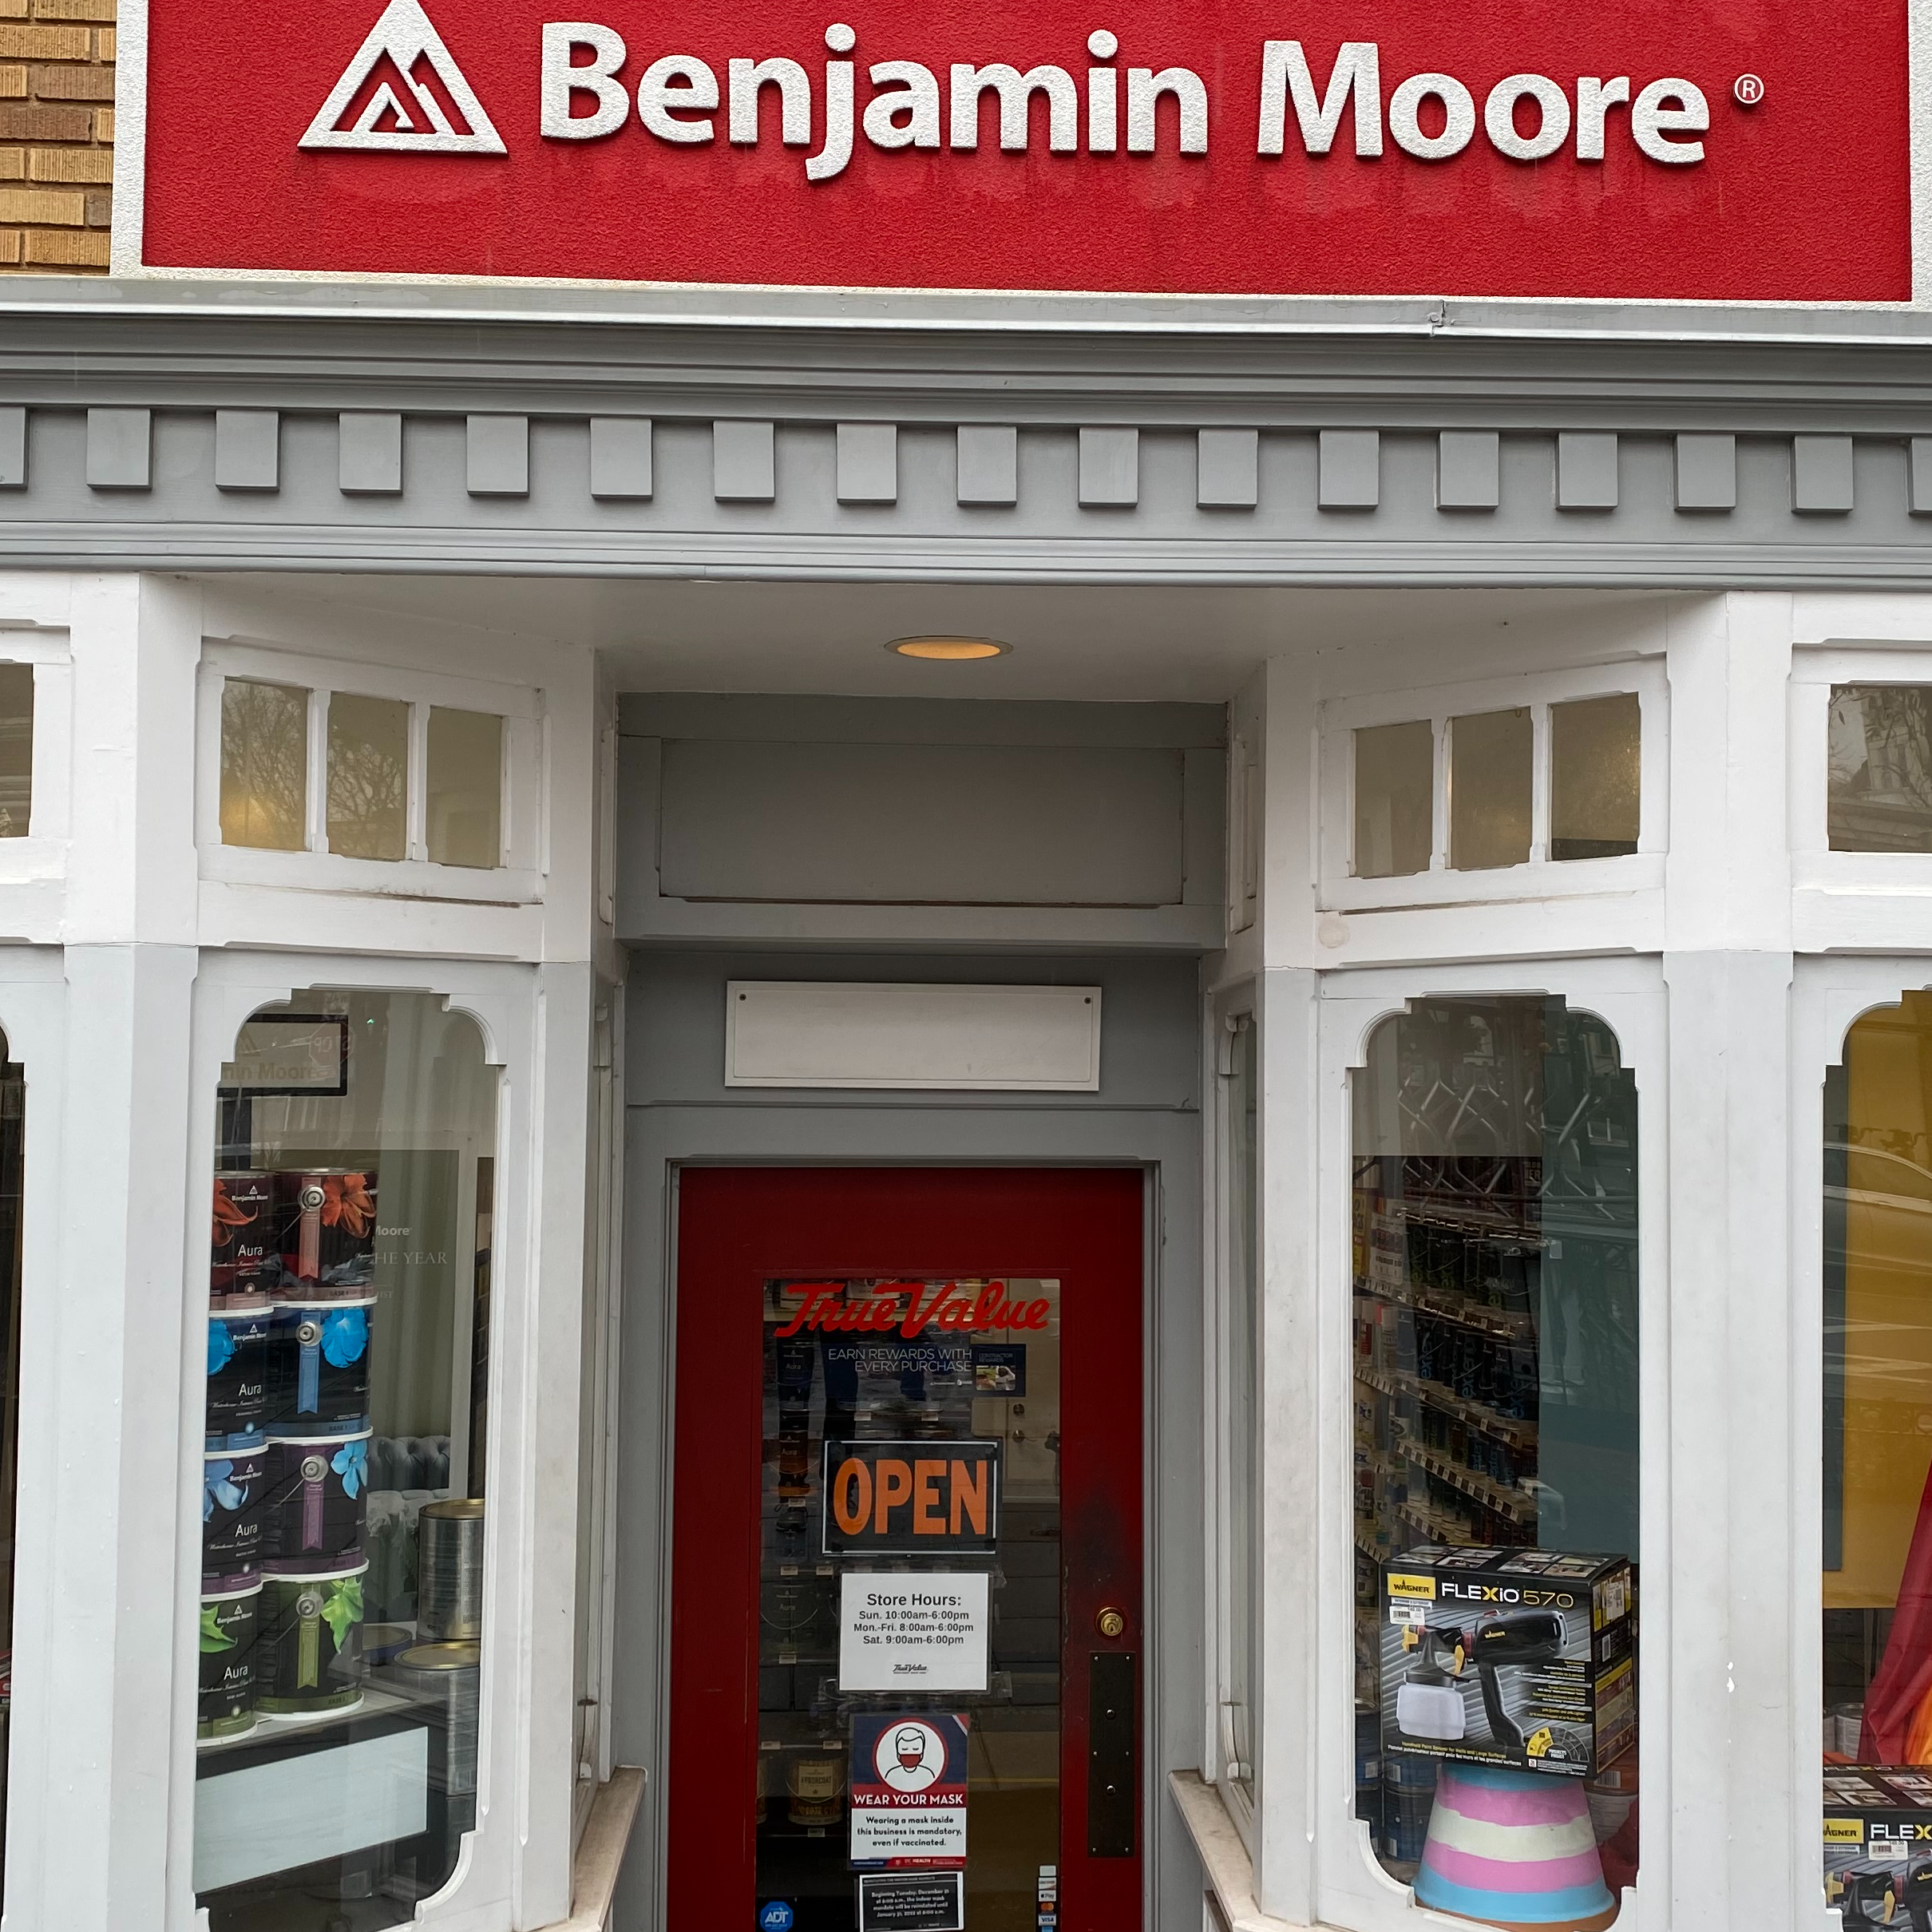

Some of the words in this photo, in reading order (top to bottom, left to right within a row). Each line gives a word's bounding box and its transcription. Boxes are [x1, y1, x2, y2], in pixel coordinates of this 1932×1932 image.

[540, 22, 1208, 182] Benjamin
[1257, 39, 1710, 164] Moore
[238, 1245, 263, 1257] Aura
[403, 1251, 448, 1265] YEAR
[773, 1282, 897, 1337] True
[873, 1280, 1050, 1338] Value
[829, 1348, 865, 1360] EARN
[869, 1348, 935, 1360] REWARDS
[938, 1348, 972, 1360] WITH
[855, 1360, 897, 1372] EVERY
[901, 1360, 972, 1372] PURCHASE
[239, 1384, 262, 1396] Aura
[833, 1457, 988, 1536] OPEN
[235, 1524, 258, 1537] Aura
[1393, 1580, 1430, 1594] WAGNER
[866, 1594, 907, 1606] Store
[912, 1594, 962, 1606] Hours:
[1523, 1590, 1574, 1609] 570
[858, 1610, 882, 1620] Sun.
[885, 1610, 969, 1621] 10:00am-6:00pm
[853, 1623, 897, 1632] Mon.-Fri.
[899, 1623, 974, 1633] 8:00am-6:00pm
[863, 1635, 883, 1645] Sat.
[885, 1635, 964, 1646] 9:00am-6:00pm
[1484, 1630, 1506, 1639] WAGNER
[224, 1665, 247, 1681] Aura
[853, 1794, 889, 1805] WEAR
[893, 1794, 926, 1805] YOUR
[929, 1794, 964, 1804] MASK
[865, 1816, 899, 1825] Wearing
[917, 1827, 962, 1836] mandatory,
[893, 1838, 899, 1847] if
[901, 1838, 947, 1847] vaccinated.
[764, 1910, 789, 1923] ADT
